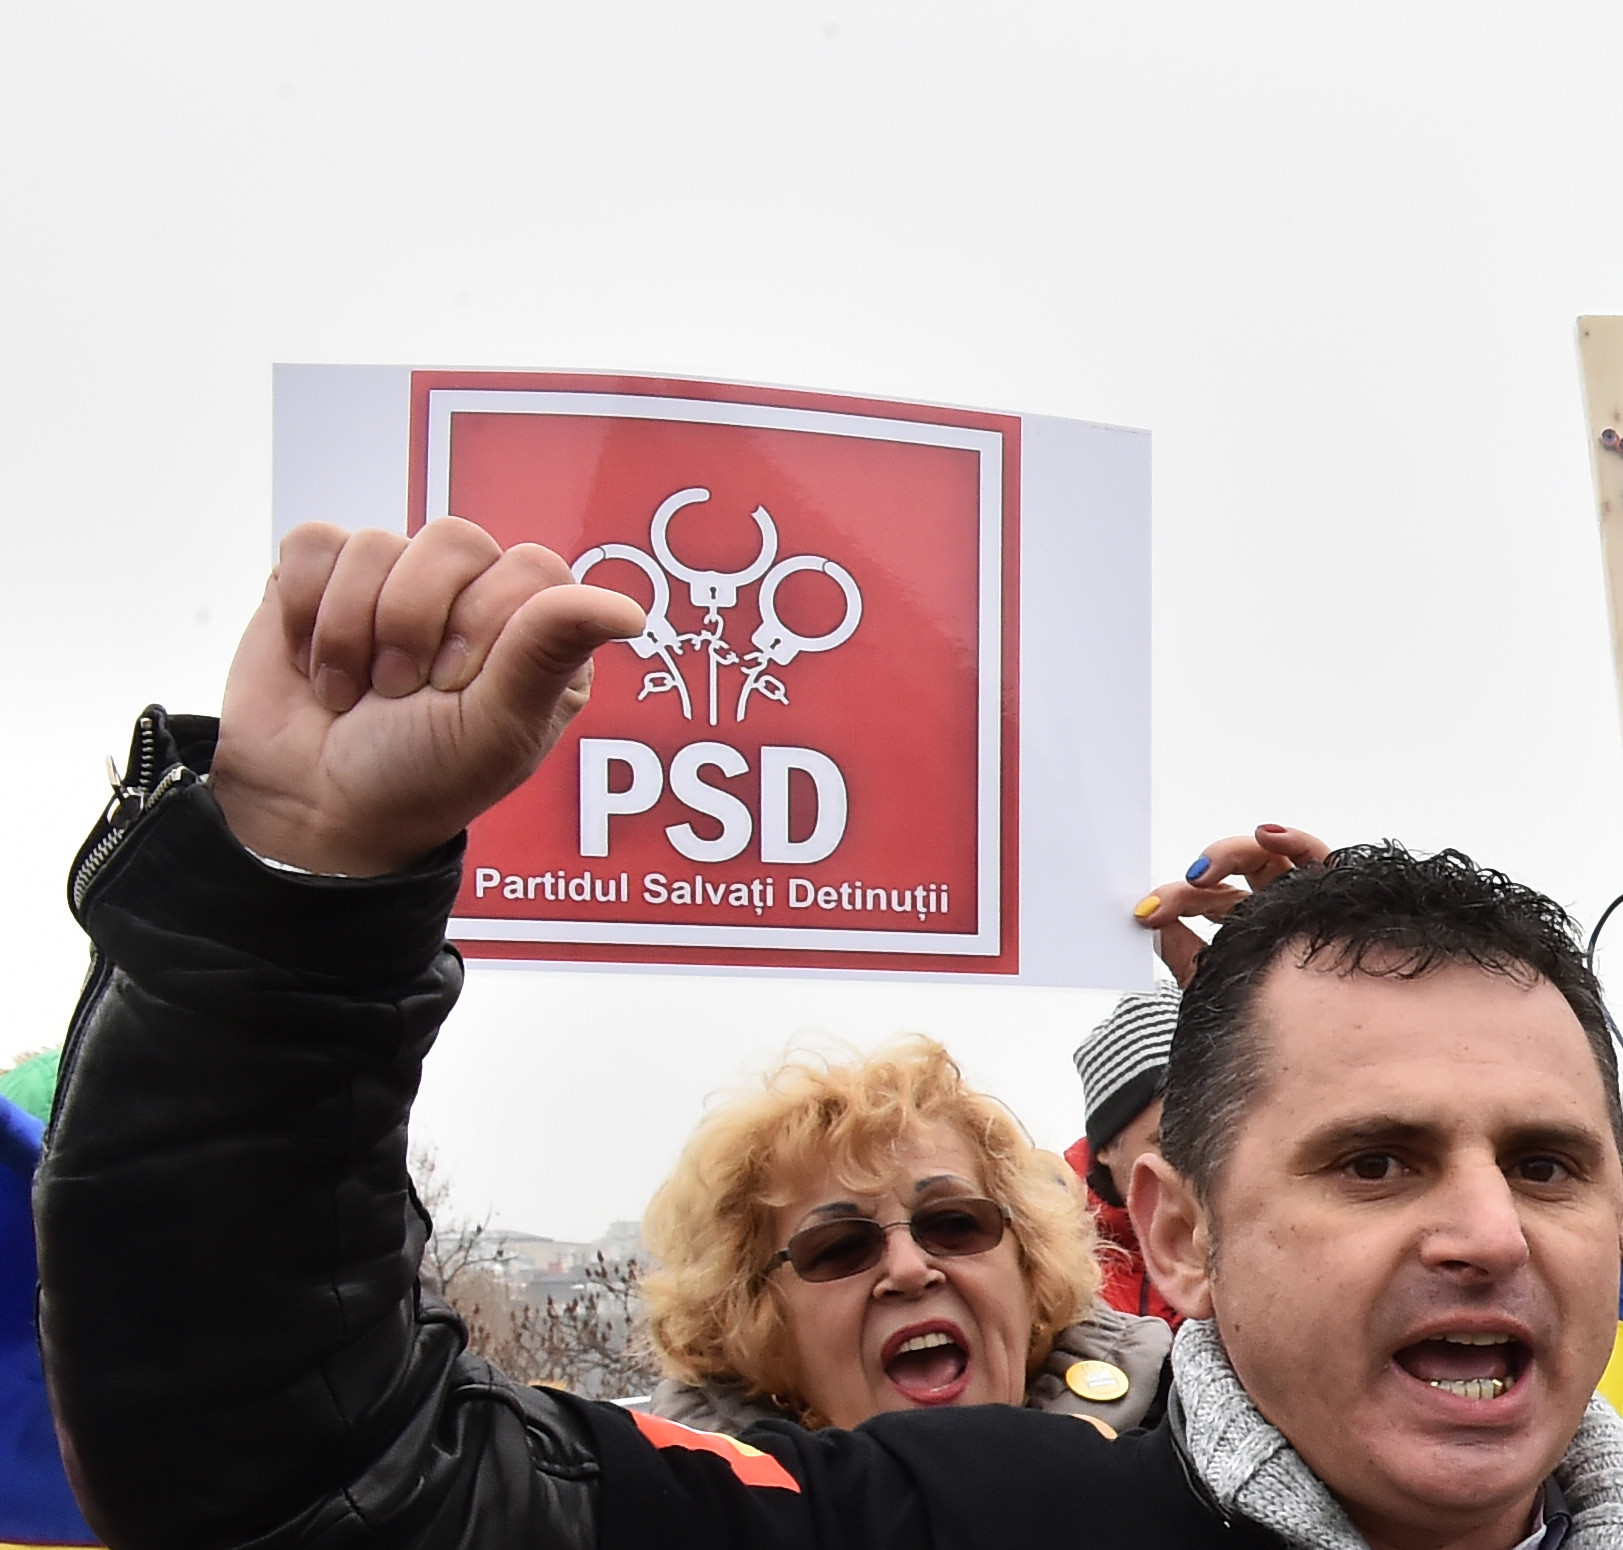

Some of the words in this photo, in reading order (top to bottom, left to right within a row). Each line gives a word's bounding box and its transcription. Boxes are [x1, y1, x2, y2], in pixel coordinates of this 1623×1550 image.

[578, 737, 850, 866] PSD
[474, 867, 629, 903] Partidul
[642, 872, 774, 916] Salvați
